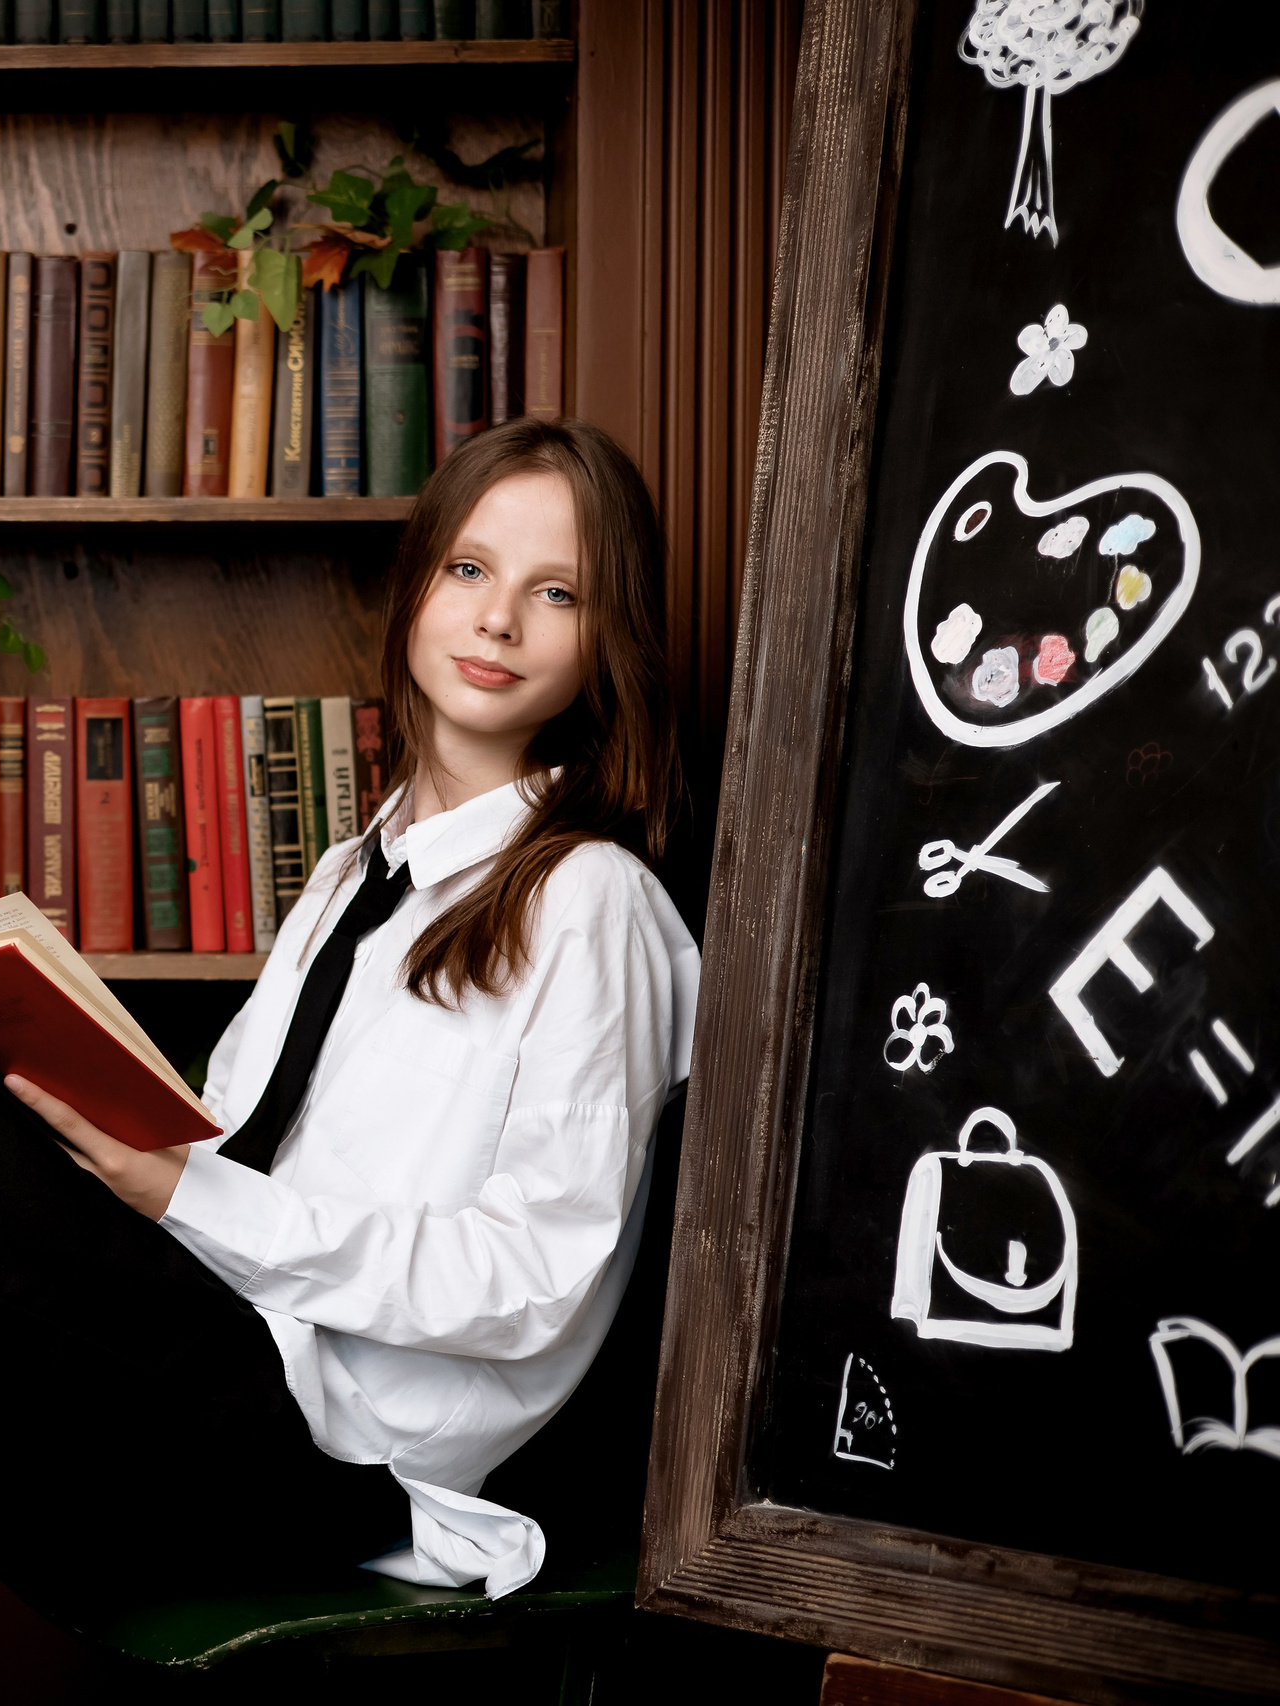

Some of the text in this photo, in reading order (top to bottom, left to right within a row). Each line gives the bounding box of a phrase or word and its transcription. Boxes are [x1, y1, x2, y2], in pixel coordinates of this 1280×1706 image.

[284, 372, 303, 461] Константин
[43, 751, 63, 899] ВИЛЬЯМ ШЕКСПИР
